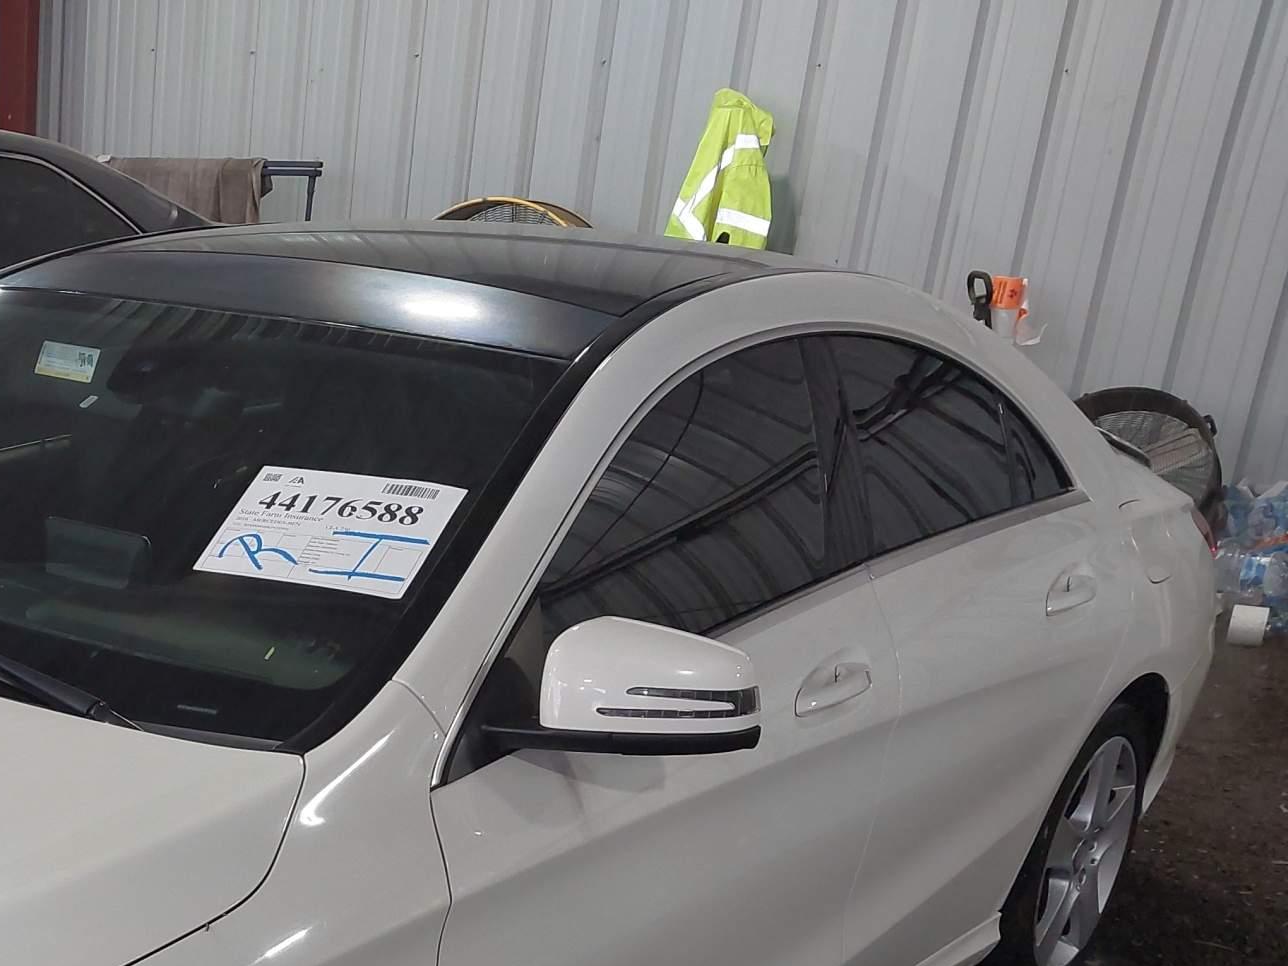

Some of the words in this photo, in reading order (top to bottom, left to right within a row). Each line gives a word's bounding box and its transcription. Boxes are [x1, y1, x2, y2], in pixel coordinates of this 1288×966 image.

[239, 508, 260, 516] State
[261, 510, 282, 518] Farm
[284, 512, 324, 522] Insurance
[258, 490, 424, 526] 44176588
